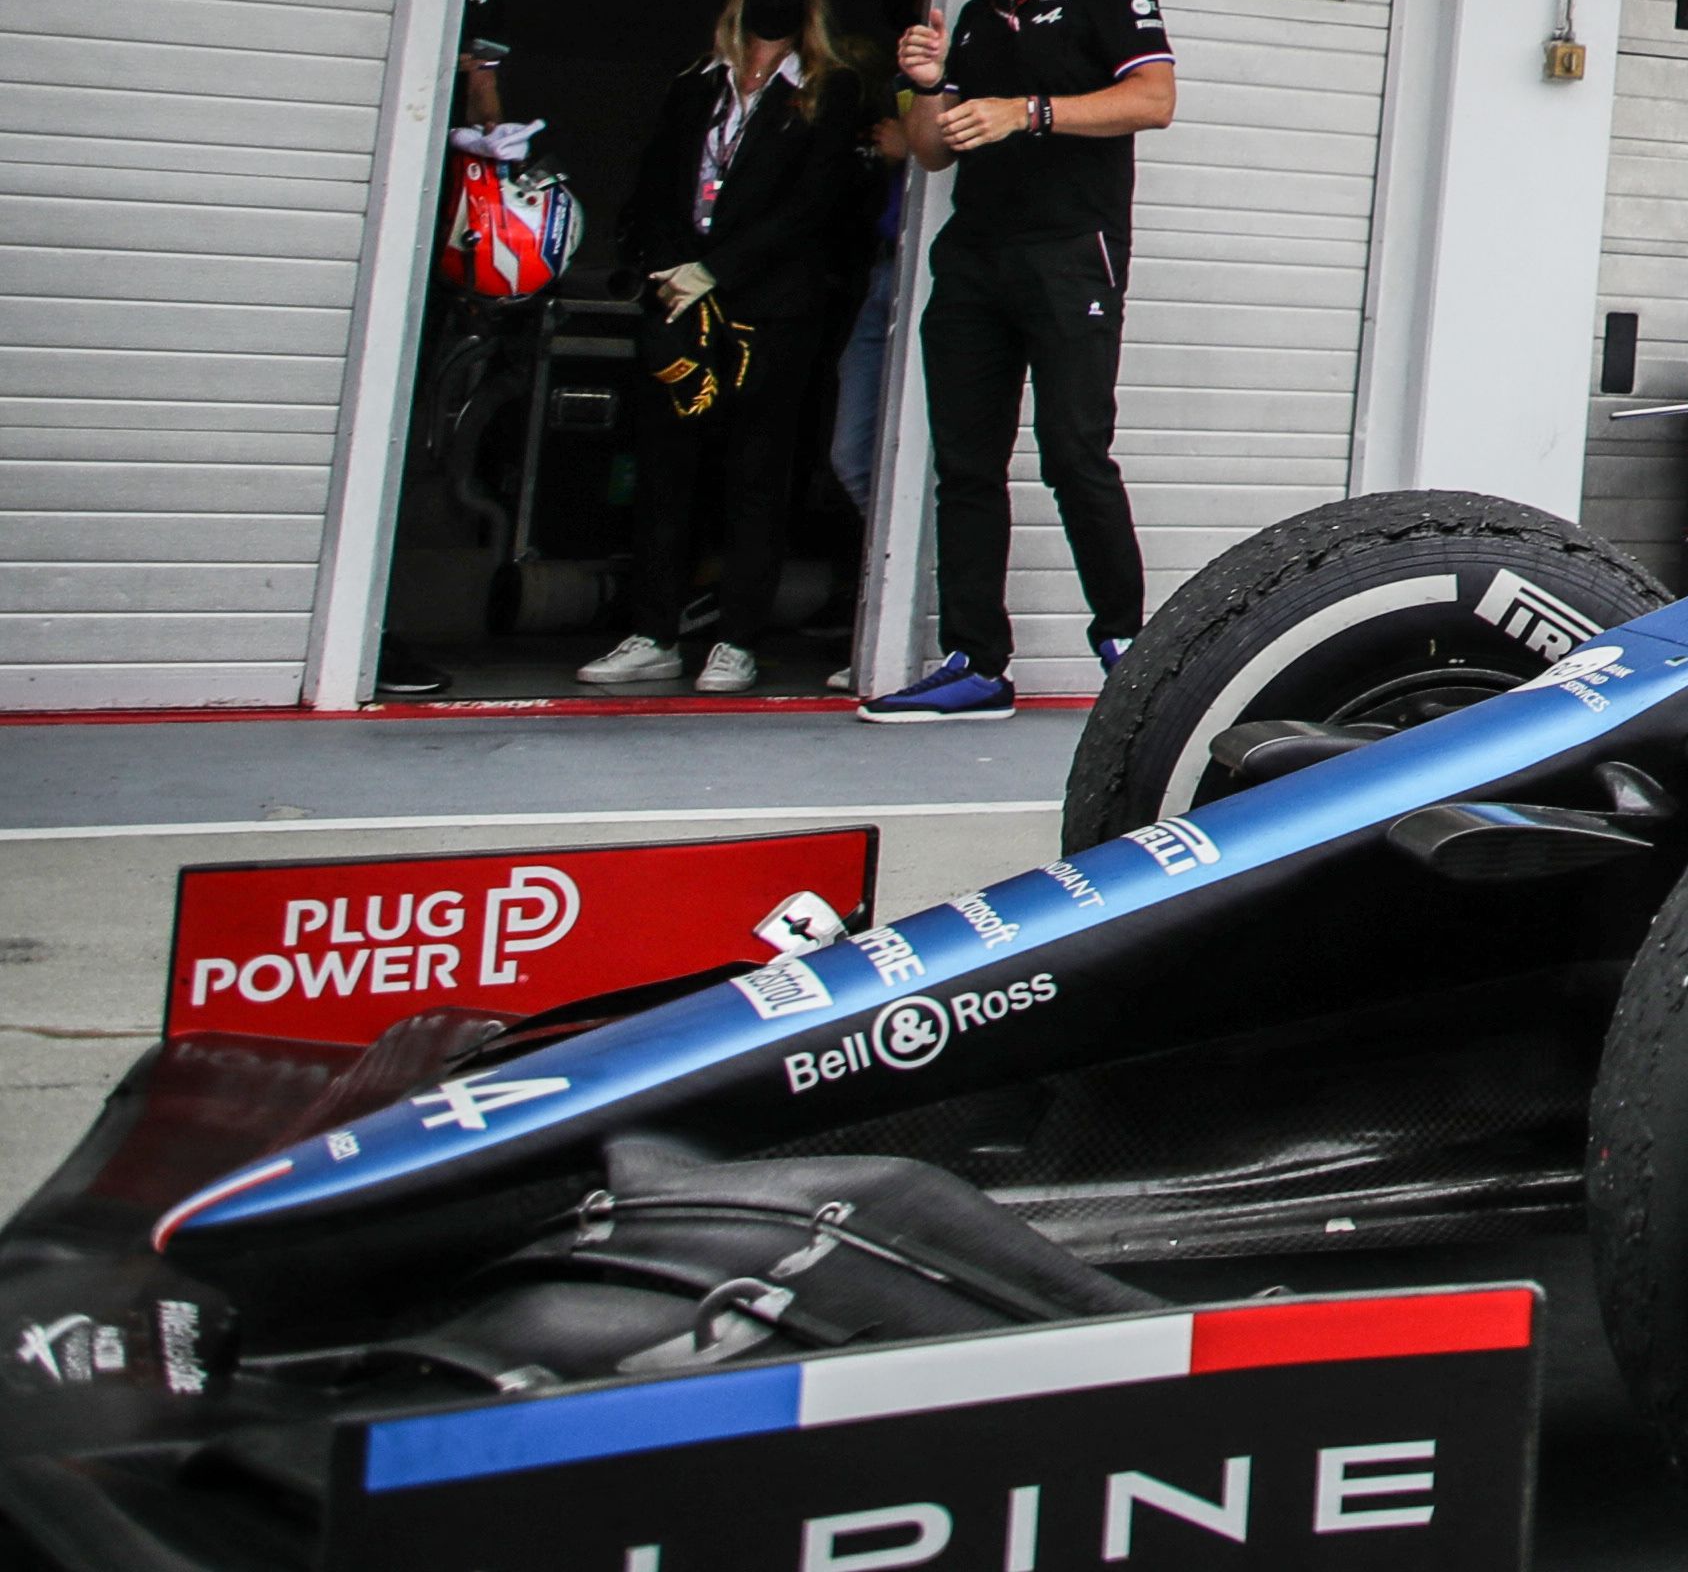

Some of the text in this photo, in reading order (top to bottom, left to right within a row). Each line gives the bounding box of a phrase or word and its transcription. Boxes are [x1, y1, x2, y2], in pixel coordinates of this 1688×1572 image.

[1560, 680, 1611, 713] SERVICES
[283, 890, 465, 947] PLUG
[190, 943, 463, 1006] POWER
[784, 1032, 872, 1094] Bell
[950, 971, 1059, 1032] Ross
